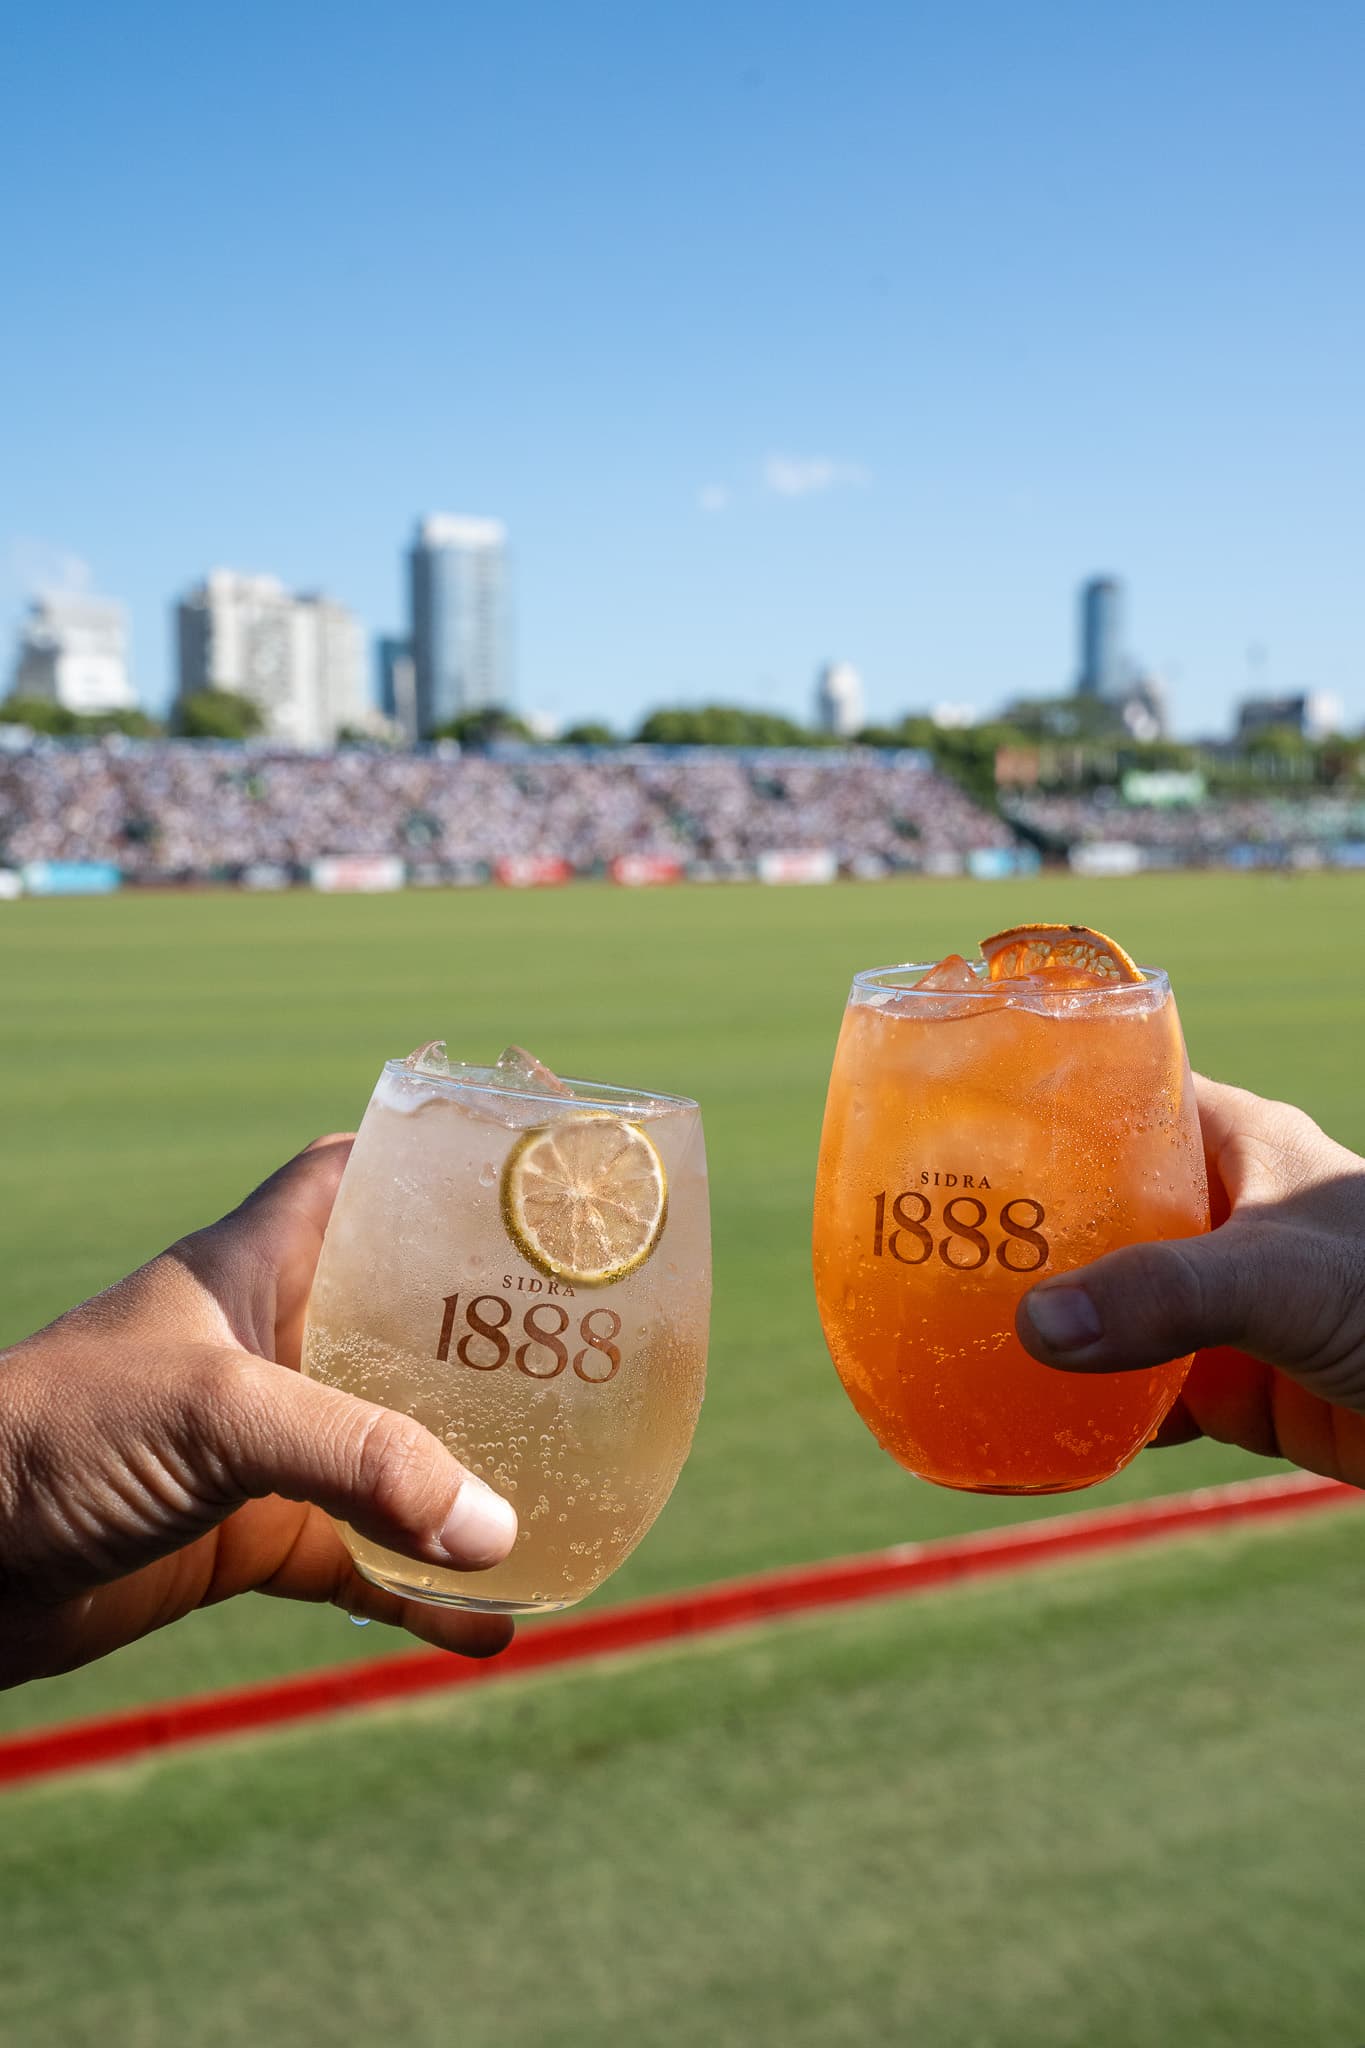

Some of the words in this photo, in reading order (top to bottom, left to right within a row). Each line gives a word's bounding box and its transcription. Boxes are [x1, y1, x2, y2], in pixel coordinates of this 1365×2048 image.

[920, 1171, 992, 1189] SIDRA
[873, 1190, 1050, 1273] 1888
[502, 1274, 576, 1297] SIDRA
[436, 1292, 622, 1384] 1888
